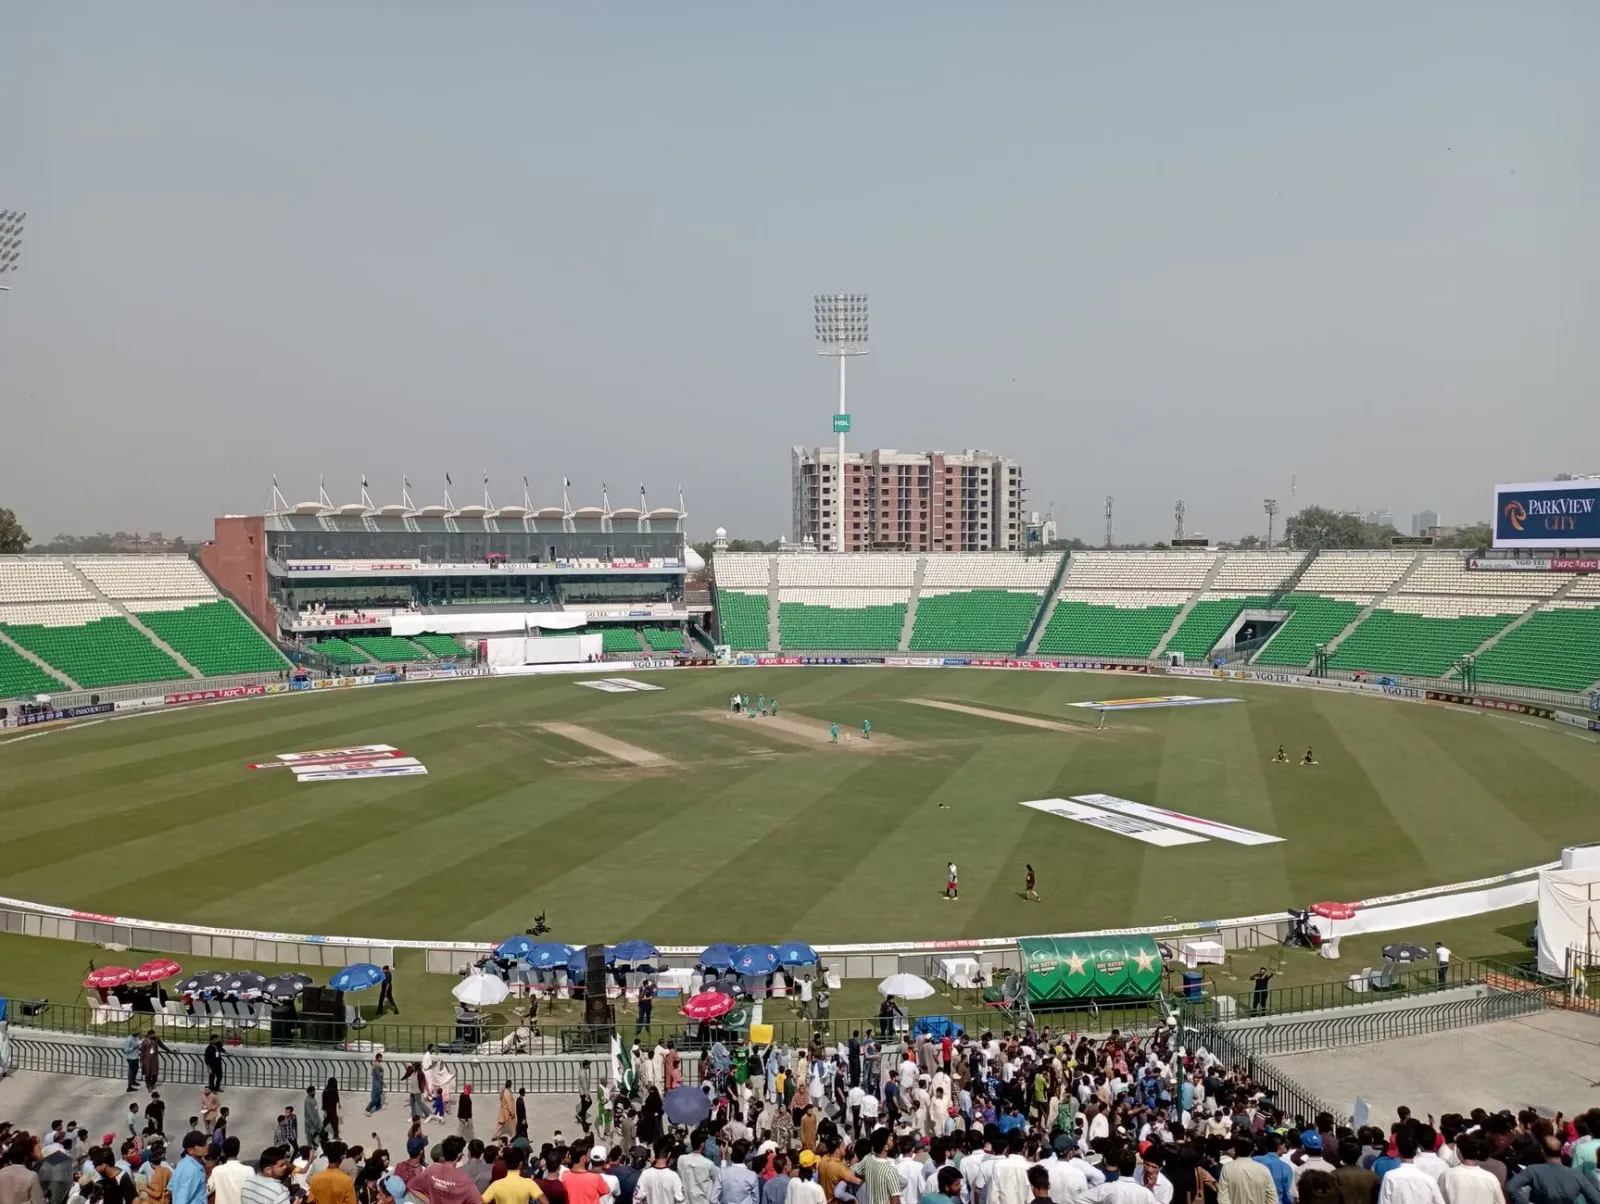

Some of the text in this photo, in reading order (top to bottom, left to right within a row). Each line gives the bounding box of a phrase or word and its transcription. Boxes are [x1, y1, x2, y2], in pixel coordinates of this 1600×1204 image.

[1528, 498, 1595, 515] PARKVIEW
[1544, 515, 1576, 530] CITY
[1557, 560, 1574, 568] KFC
[1580, 560, 1597, 568] KFC
[477, 667, 491, 675] TEL
[1256, 672, 1273, 681] VGO
[1275, 674, 1291, 682] TEL
[224, 689, 240, 697] KFC
[1382, 685, 1401, 696] VGO
[1403, 688, 1421, 698] TEL
